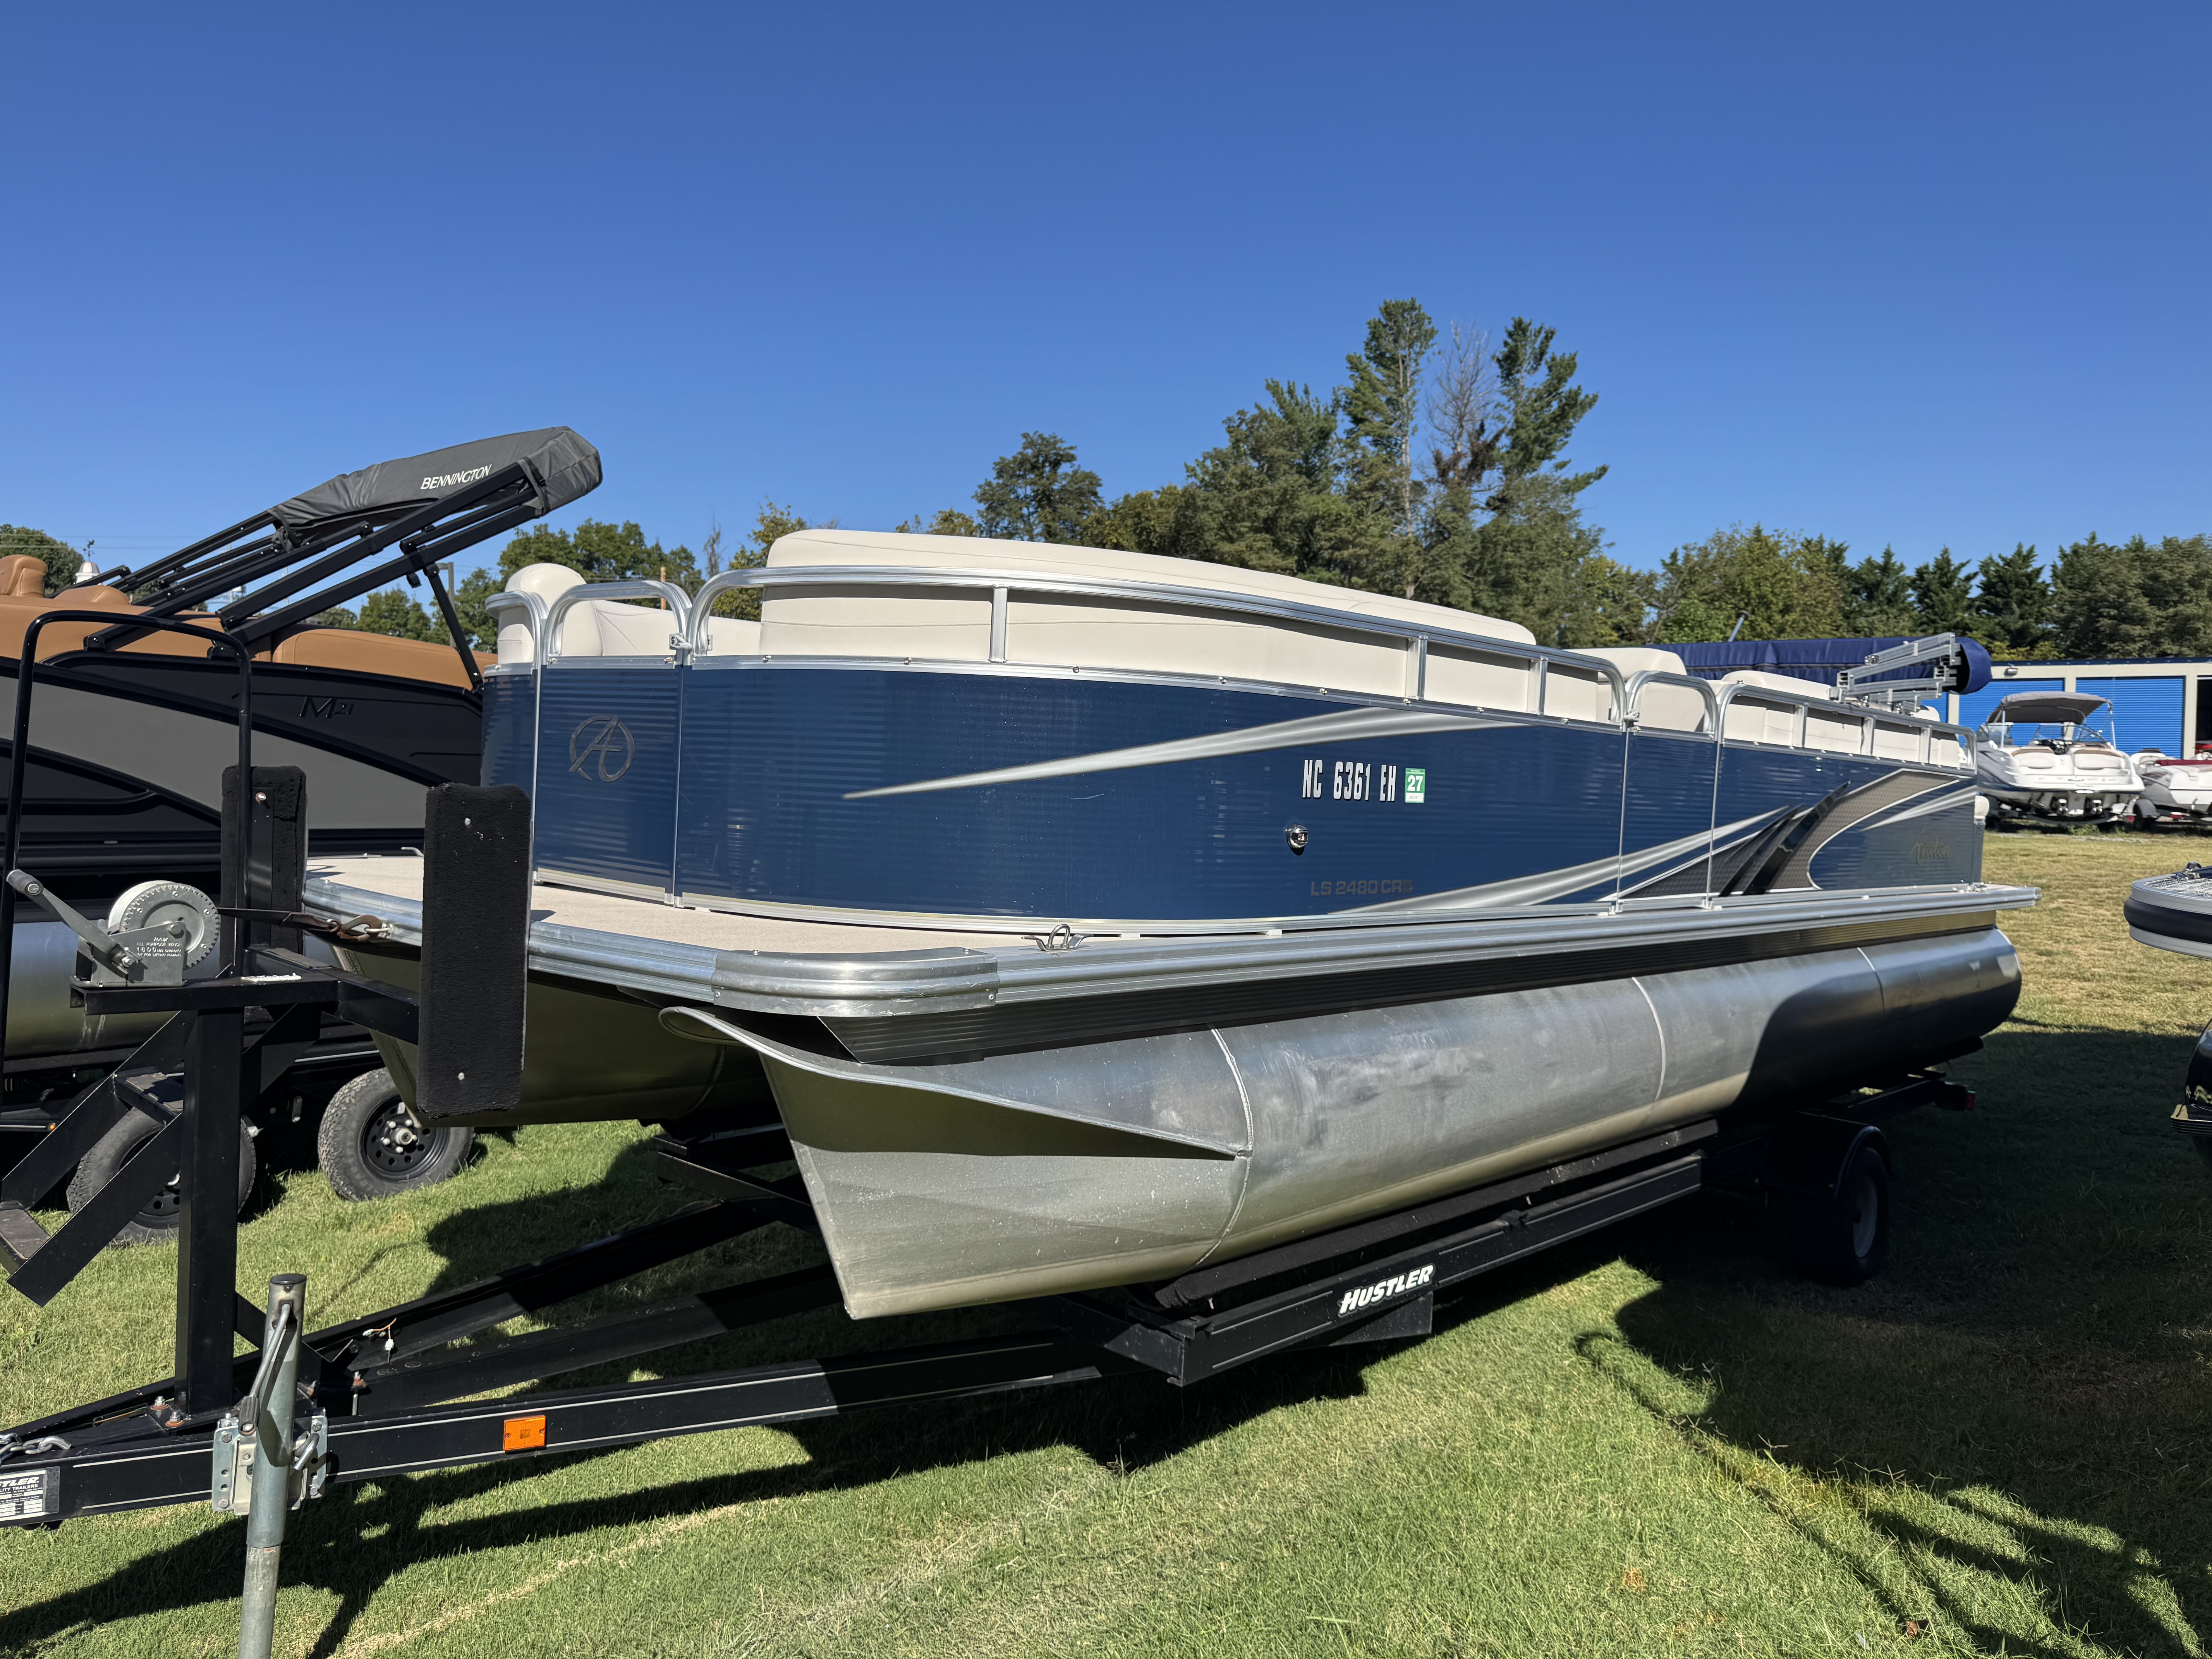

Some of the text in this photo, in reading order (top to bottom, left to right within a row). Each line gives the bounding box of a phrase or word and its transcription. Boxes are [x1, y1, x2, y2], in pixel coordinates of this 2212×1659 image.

[421, 464, 492, 490] BENNINGTON
[1302, 760, 1396, 801] NC 6361 EH
[1407, 775, 1423, 791] 27
[1311, 881, 1332, 896] LS
[1335, 880, 1378, 895] 2480
[1339, 1265, 1434, 1314] HUSTLER
